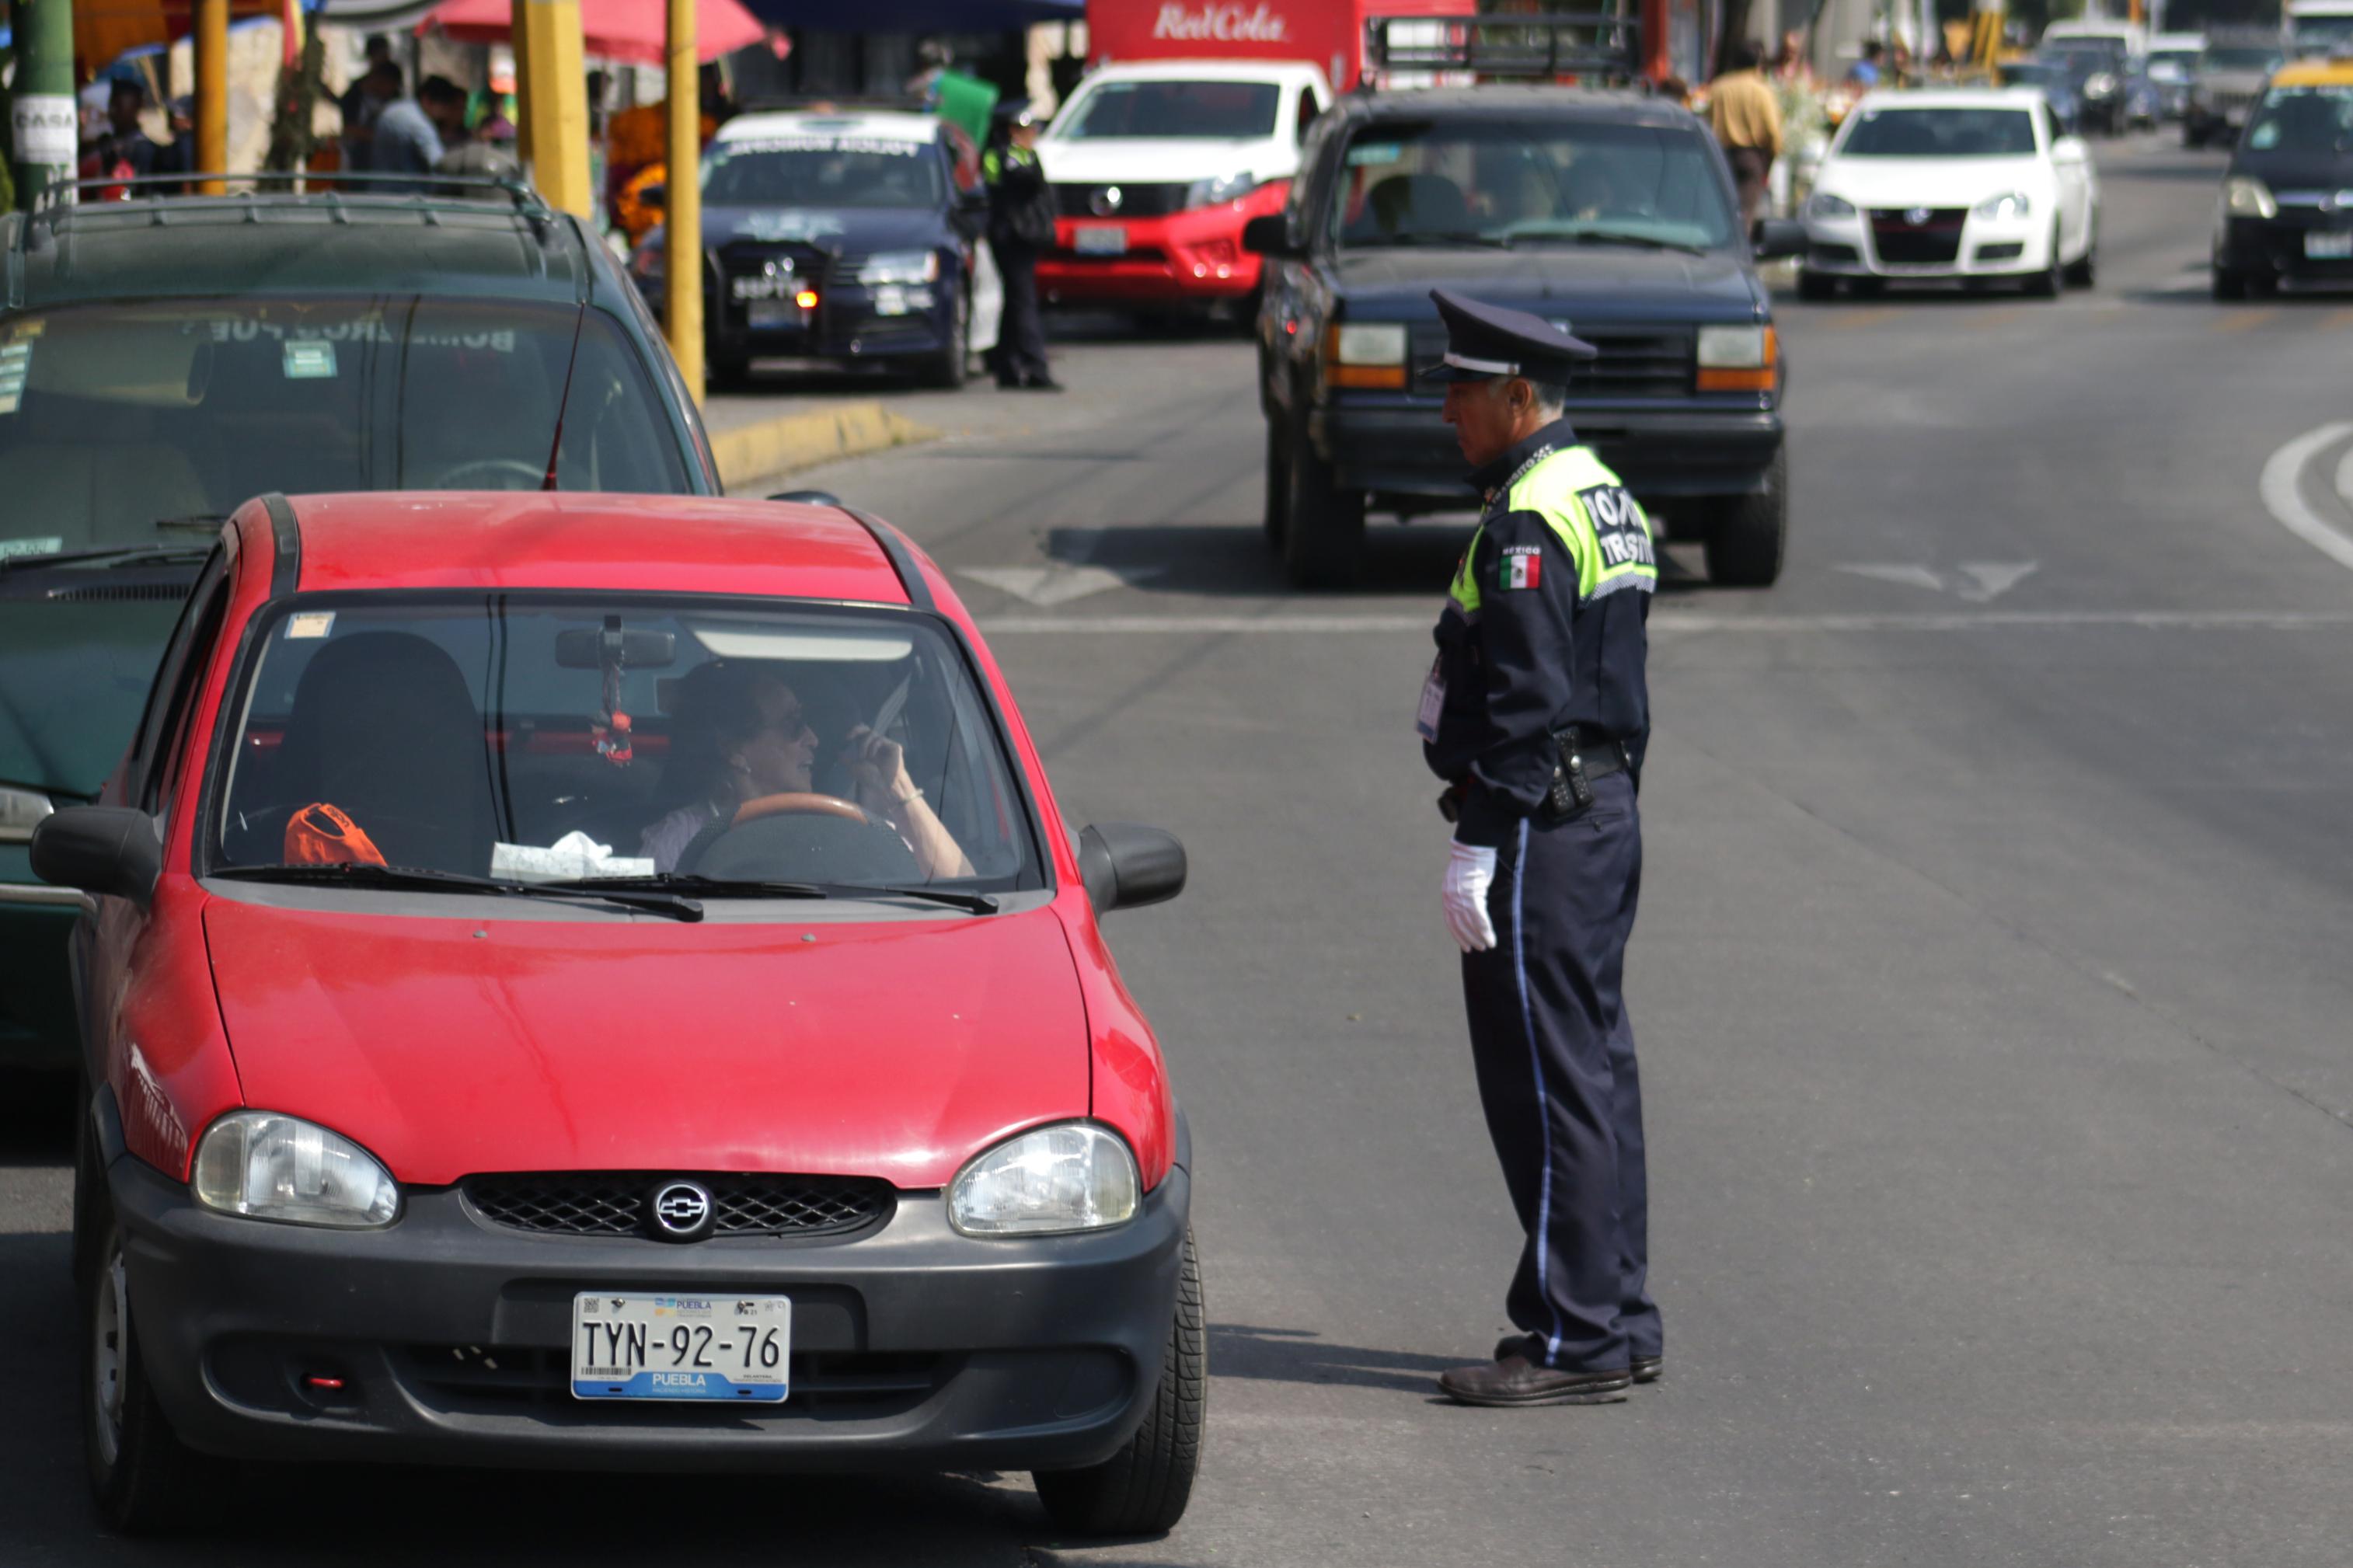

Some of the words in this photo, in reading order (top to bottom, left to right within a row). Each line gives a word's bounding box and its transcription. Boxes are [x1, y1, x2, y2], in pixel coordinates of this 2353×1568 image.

[1152, 2, 1285, 42] RedCola
[1503, 545, 1542, 555] MEXICO
[676, 1300, 712, 1310] PUEBLA
[583, 1322, 779, 1368] TYN-92-76
[651, 1373, 706, 1386] PUEBLA
